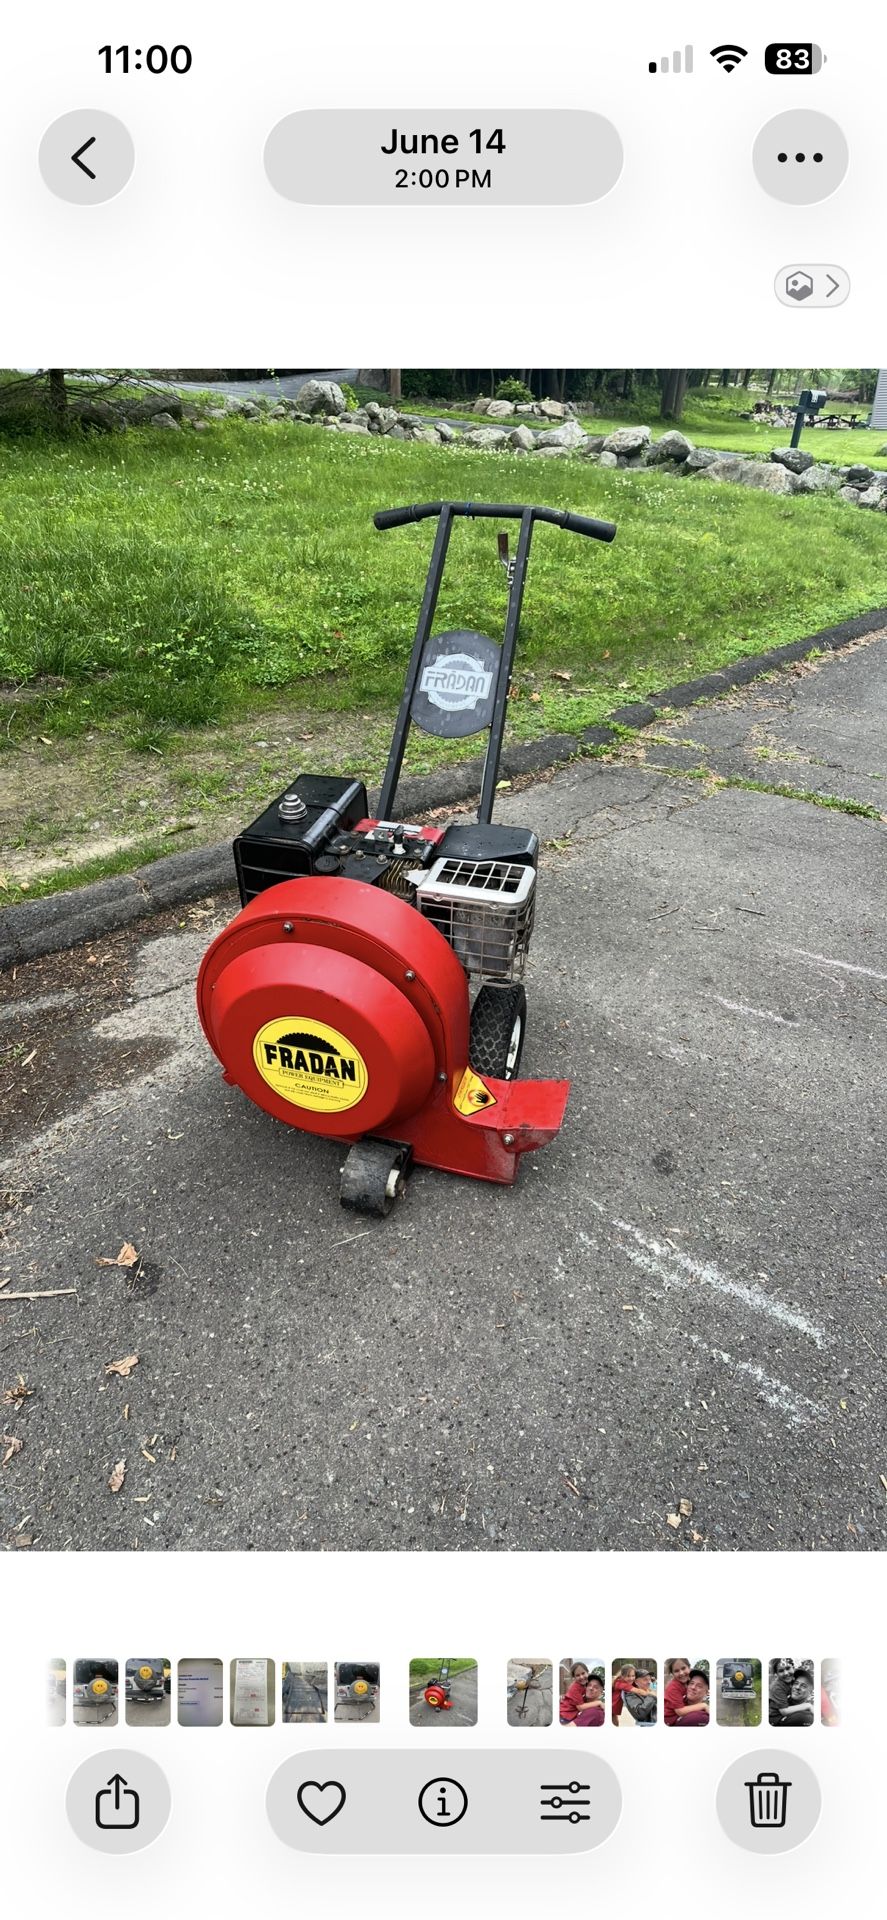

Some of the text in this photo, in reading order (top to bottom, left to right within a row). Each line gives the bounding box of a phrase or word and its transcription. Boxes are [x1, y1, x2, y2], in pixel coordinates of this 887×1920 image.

[425, 671, 486, 693] FRADAN
[264, 1043, 356, 1082] FRADAN
[281, 1070, 341, 1086] POWER EQUIPMENT
[294, 1082, 330, 1094] CAUTION
